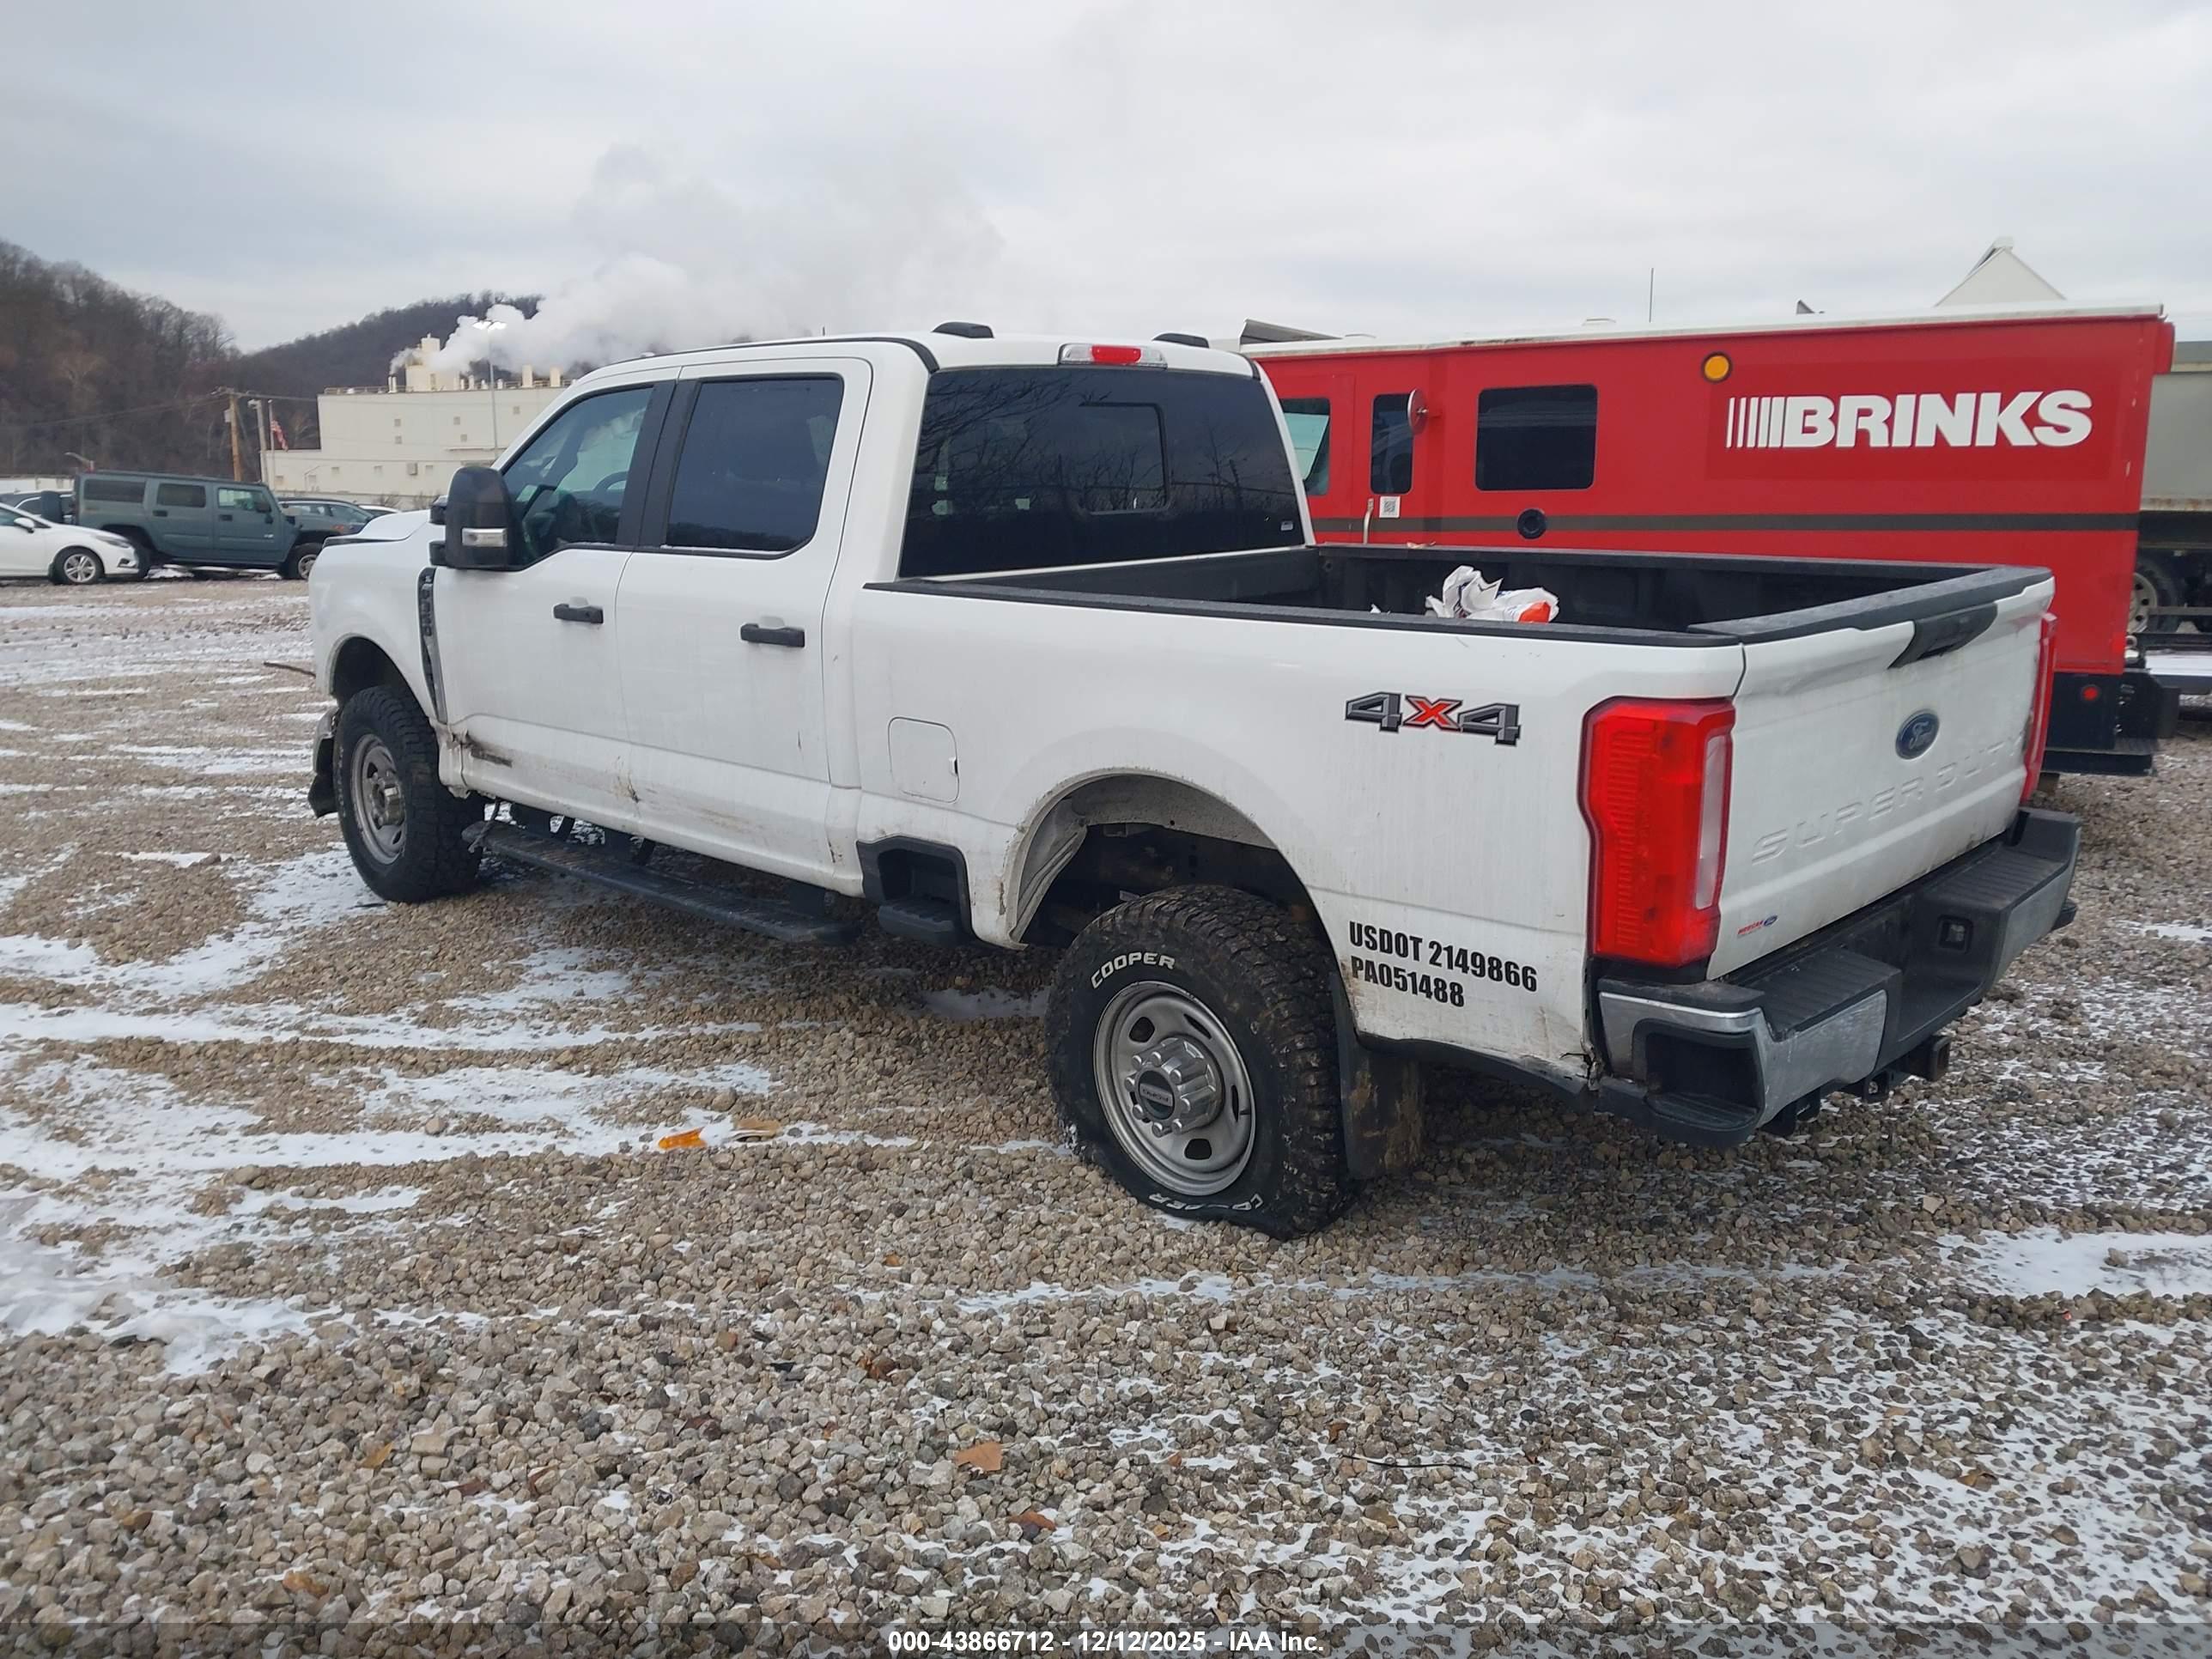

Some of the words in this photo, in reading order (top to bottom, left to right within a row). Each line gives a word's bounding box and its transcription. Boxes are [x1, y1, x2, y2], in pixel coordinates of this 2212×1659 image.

[1781, 389, 2093, 448] BRINKS
[1752, 776, 1924, 866] SUPER
[1091, 951, 1176, 989] COOPER
[1349, 921, 1423, 962] USDOT
[1429, 940, 1537, 992] 2149866
[1351, 956, 1465, 1007] PA051488
